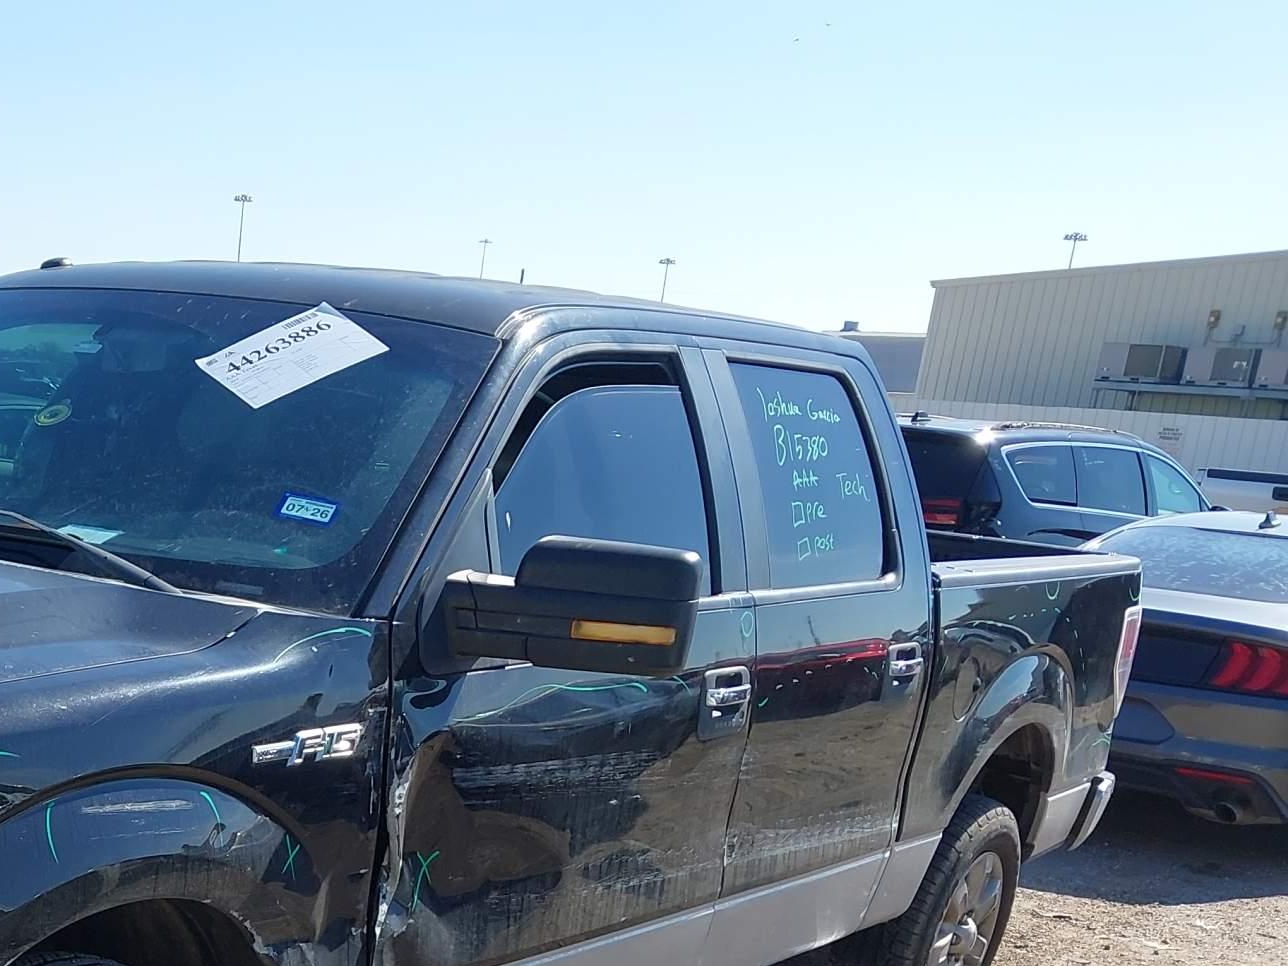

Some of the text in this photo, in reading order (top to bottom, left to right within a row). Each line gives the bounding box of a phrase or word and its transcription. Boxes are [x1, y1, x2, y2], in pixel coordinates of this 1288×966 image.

[225, 319, 332, 373] 44263886
[836, 472, 870, 502] Tech
[310, 507, 330, 519] 26
